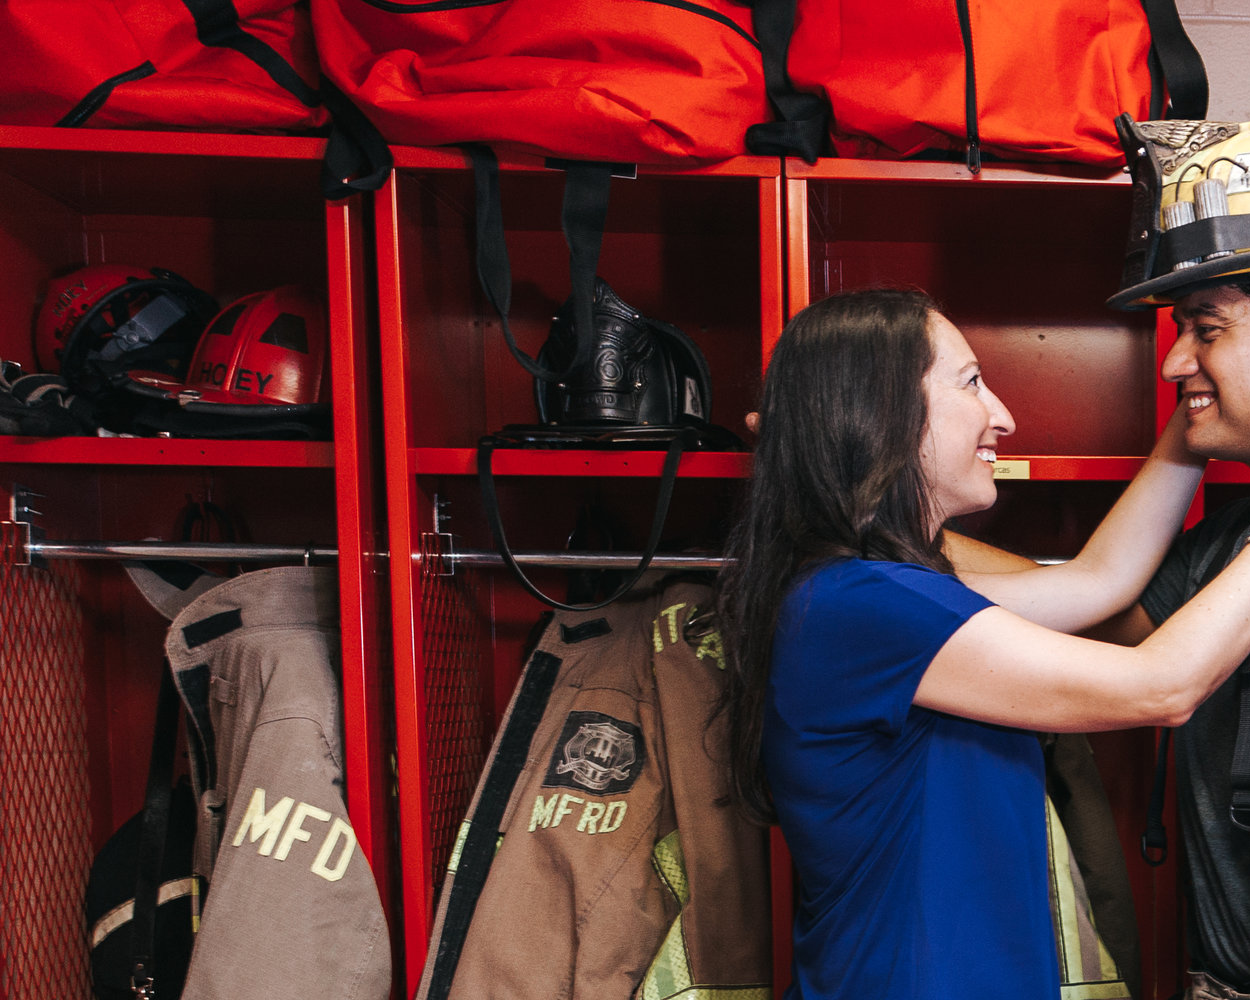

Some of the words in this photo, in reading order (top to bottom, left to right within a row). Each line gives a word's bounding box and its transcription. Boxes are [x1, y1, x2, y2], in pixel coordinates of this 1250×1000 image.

[994, 466, 1011, 474] rcas
[231, 787, 357, 882] MFD
[527, 793, 628, 835] MFRD
